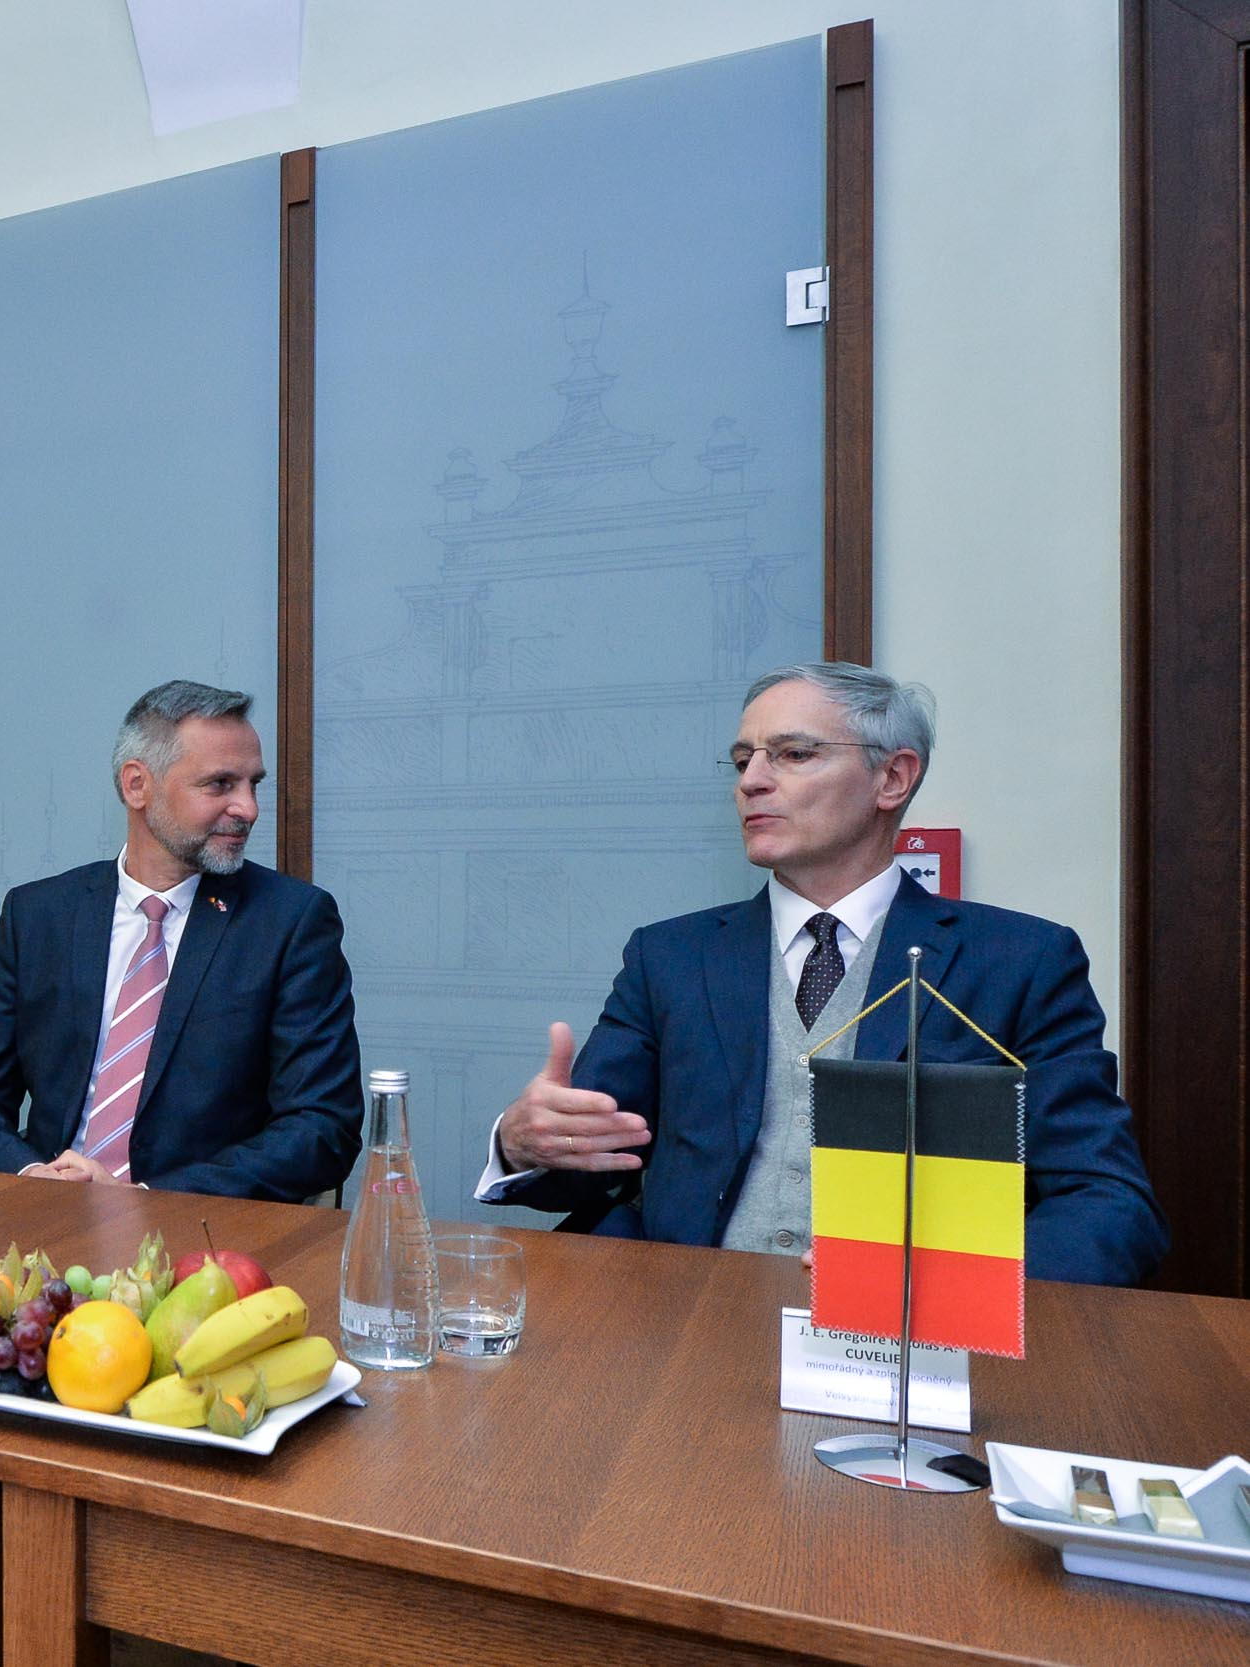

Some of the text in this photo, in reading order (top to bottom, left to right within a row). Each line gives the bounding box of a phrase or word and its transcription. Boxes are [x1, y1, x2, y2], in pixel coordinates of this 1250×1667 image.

[799, 1325, 809, 1336] J.
[813, 1327, 824, 1338] E.
[845, 1348, 902, 1365] CUVELIE
[806, 1360, 863, 1375] mimořádný
